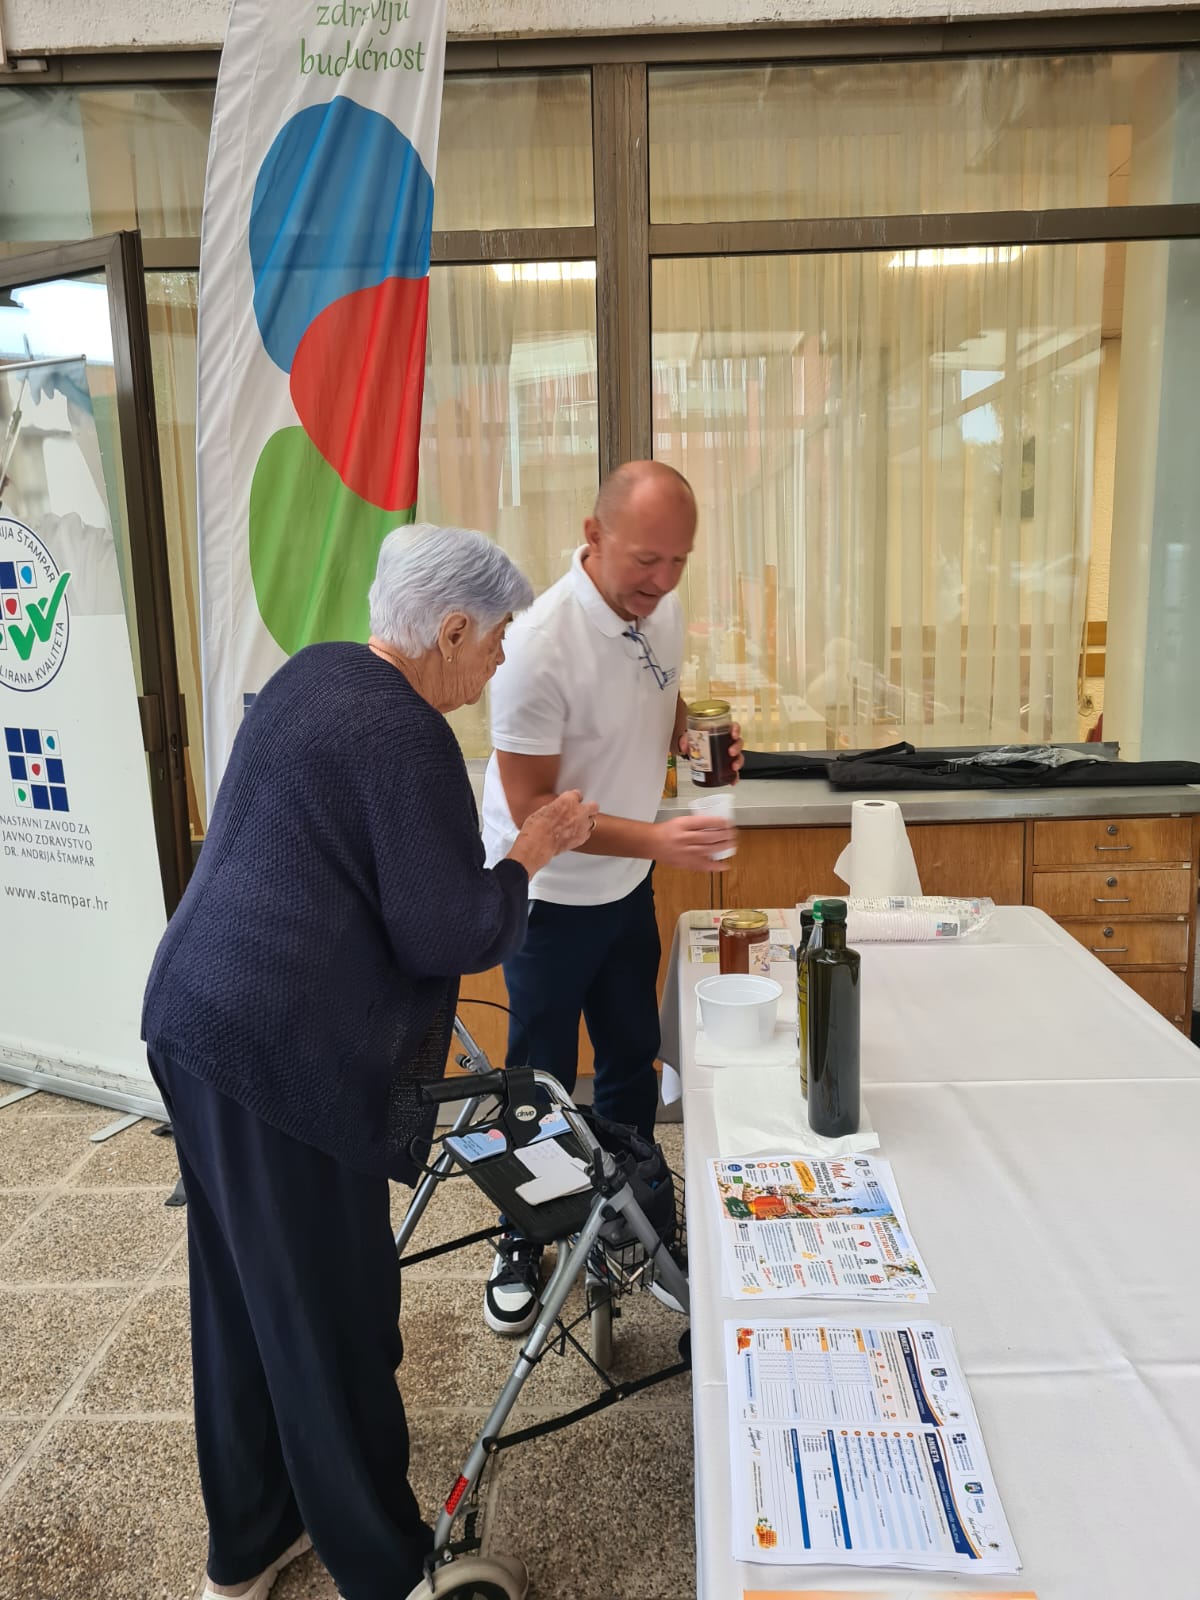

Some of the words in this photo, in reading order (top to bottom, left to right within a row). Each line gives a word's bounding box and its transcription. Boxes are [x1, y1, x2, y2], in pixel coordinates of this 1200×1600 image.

[300, 37, 426, 77] budućnost
[17, 528, 56, 583] ŠTAMPAR
[35, 622, 64, 681] KVALITETA
[0, 815, 42, 829] NASTAVNI
[44, 819, 76, 833] ZAVOD
[78, 823, 91, 835] ZA
[2, 830, 33, 843] JAVNO
[35, 834, 93, 851] ZDRAVSTVO
[4, 845, 19, 857] DR.
[21, 848, 56, 863] ANDRIJA
[56, 849, 95, 867] ŠTAMPAR
[4, 885, 109, 911] www.stampar.hr
[926, 1433, 940, 1463] ANKETA
